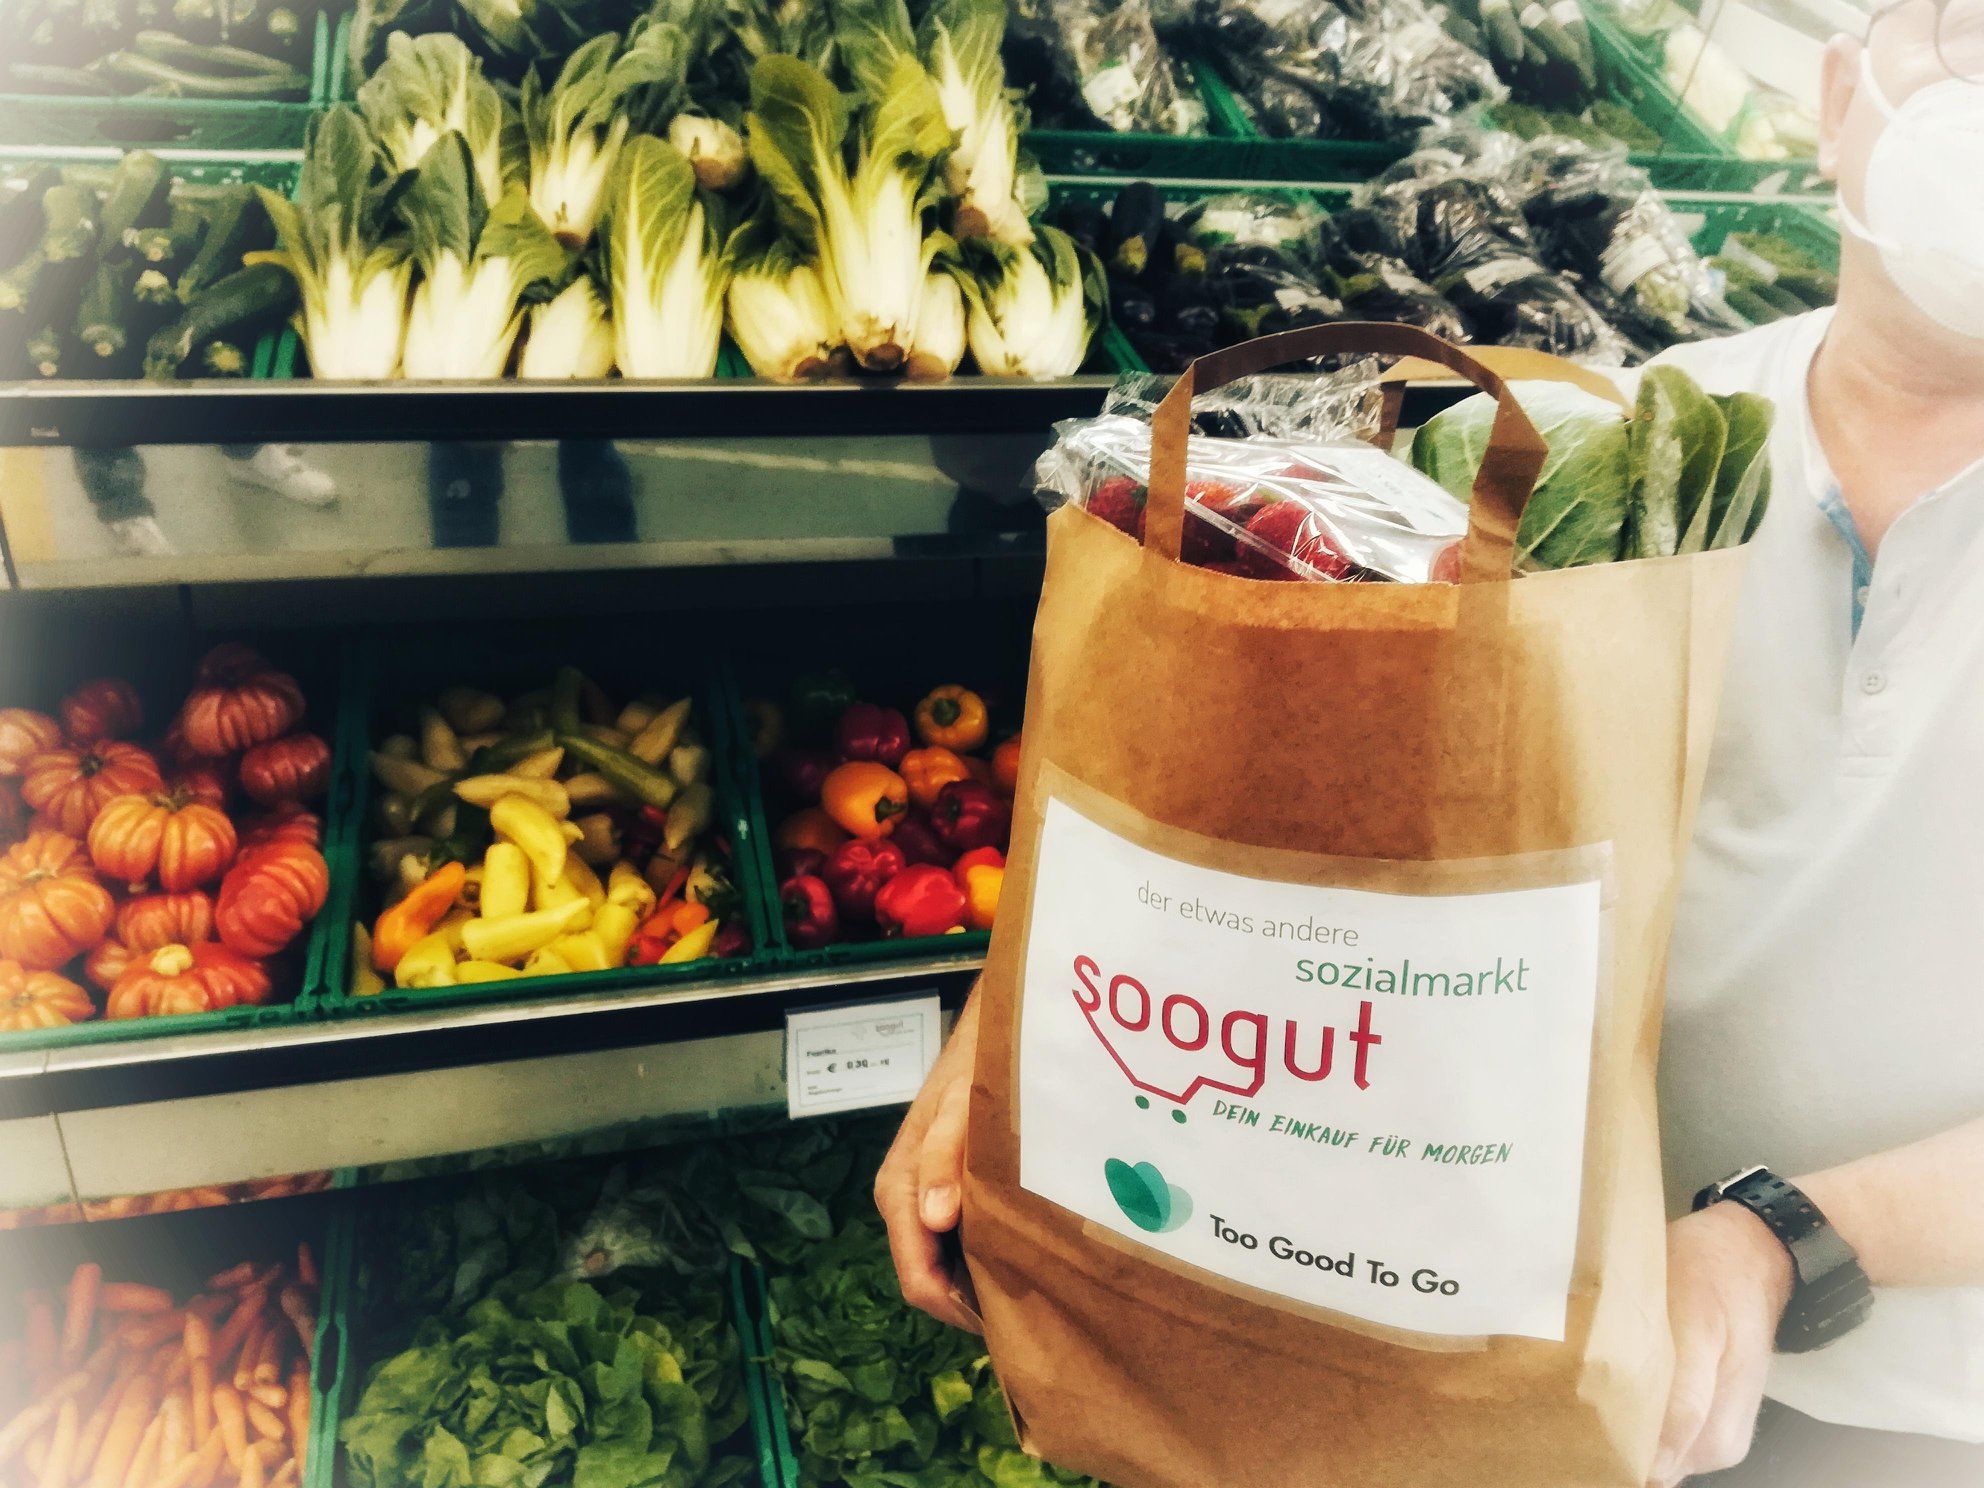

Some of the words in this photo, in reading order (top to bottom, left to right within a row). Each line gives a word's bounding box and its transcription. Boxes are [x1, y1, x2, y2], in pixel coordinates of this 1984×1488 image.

[1139, 881, 1171, 911] der
[1180, 898, 1253, 933] etwas
[1263, 916, 1358, 946] andere
[1296, 957, 1529, 996] sozialmarkt
[1073, 955, 1383, 1104] soogut
[1213, 1100, 1260, 1127] DEIN
[1269, 1115, 1359, 1148] EINKAUF
[1368, 1135, 1411, 1158] FÜR
[1421, 1143, 1513, 1165] MORGEN
[1210, 1214, 1258, 1249] Too
[1269, 1236, 1355, 1278] Good
[1367, 1260, 1399, 1287] To
[1412, 1269, 1459, 1296] Go
